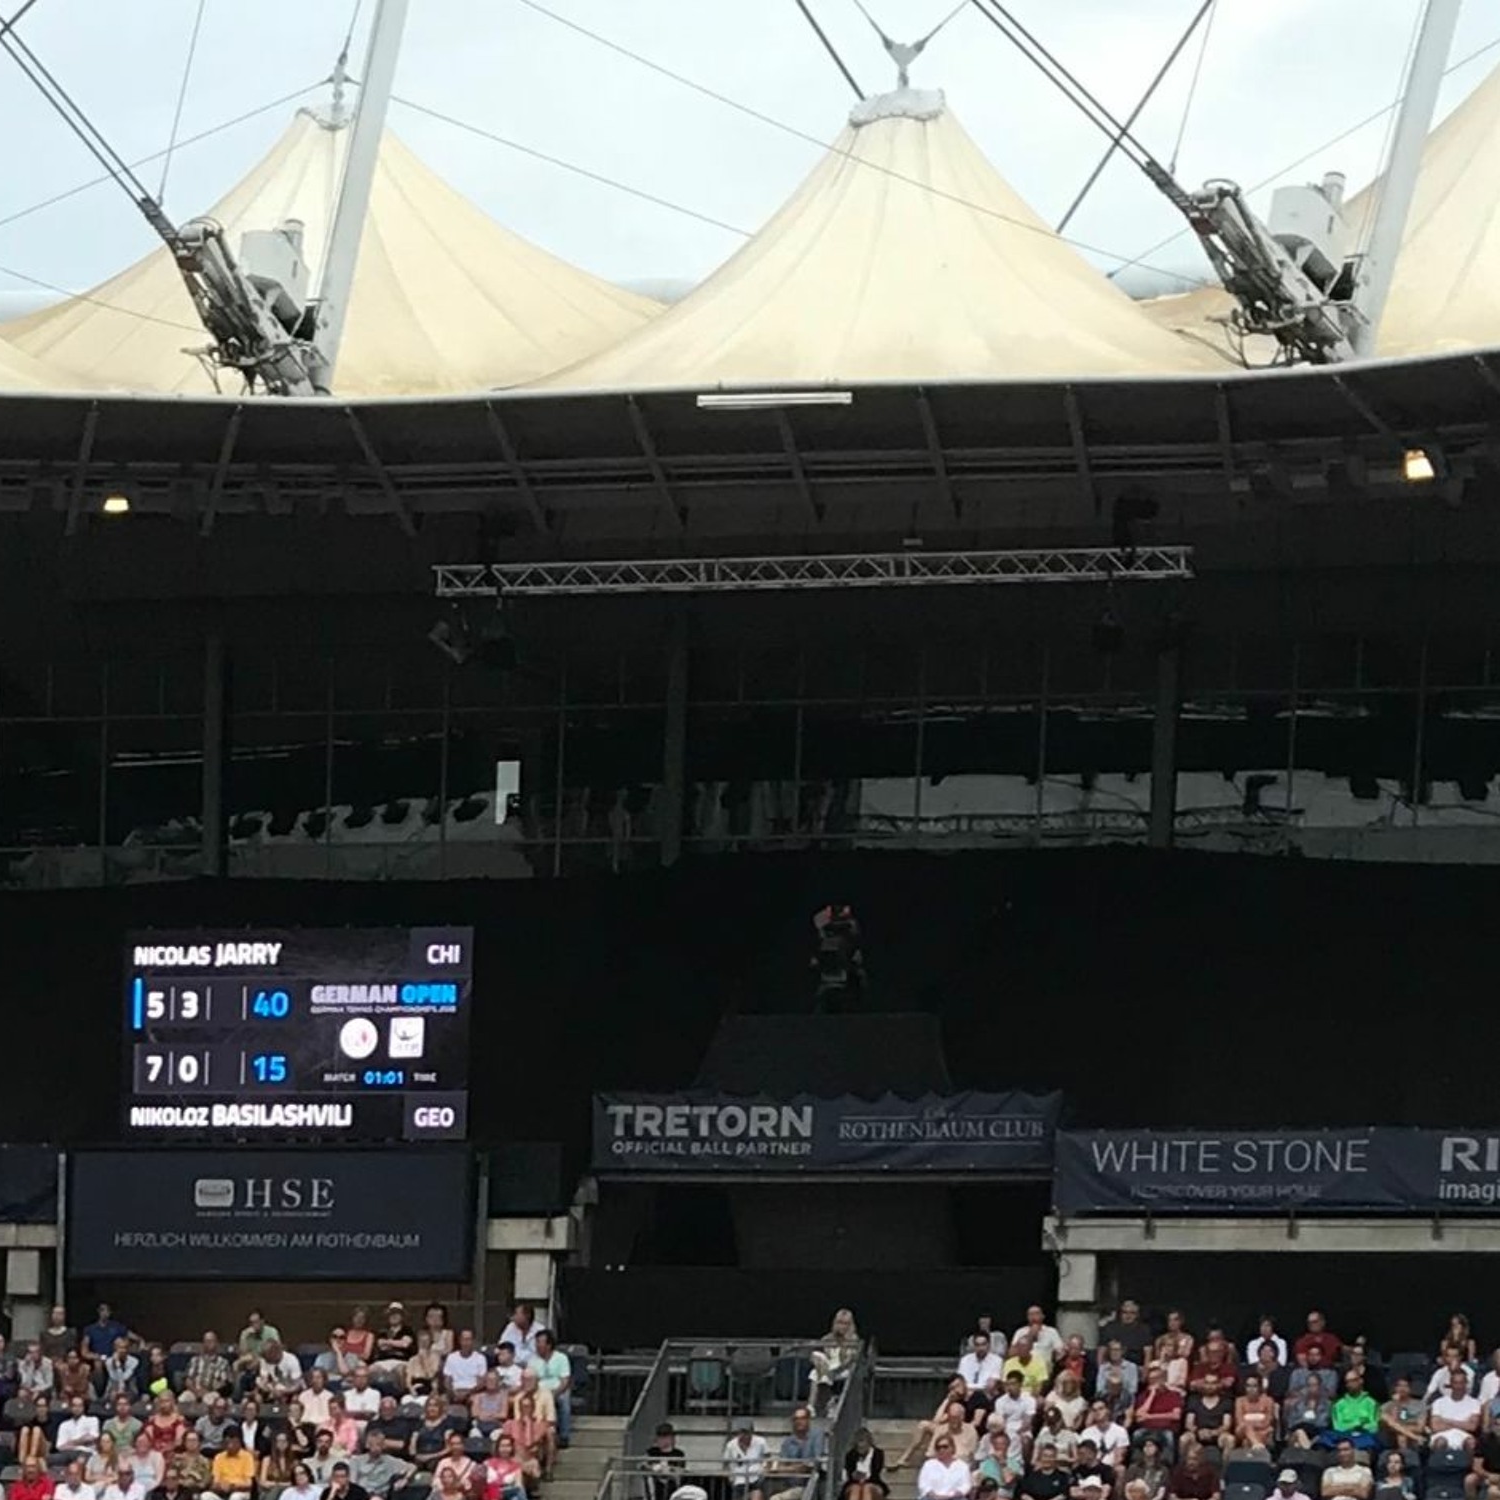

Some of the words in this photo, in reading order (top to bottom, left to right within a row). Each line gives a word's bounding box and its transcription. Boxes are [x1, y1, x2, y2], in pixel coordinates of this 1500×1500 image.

[133, 945, 211, 966] NICOLAS
[214, 942, 282, 967] JARRY
[426, 944, 461, 964] CHI
[146, 991, 165, 1019] 5
[180, 991, 199, 1019] 3
[253, 991, 289, 1018] 40
[310, 984, 397, 1005] GERMAN
[400, 983, 457, 1005] OPEN
[146, 1056, 164, 1083] 7
[178, 1055, 199, 1083] 0
[253, 1056, 287, 1082] 15
[363, 1071, 404, 1085] 01:01
[130, 1106, 209, 1127] NIKOLOZ
[211, 1104, 352, 1127] BASILASHVILI
[414, 1107, 454, 1128] GEO
[606, 1104, 813, 1139] TRETORN
[838, 1120, 985, 1140] ROTHENBAUM
[989, 1119, 1044, 1139] CLUB
[611, 1140, 686, 1156] OFFICIAL
[690, 1140, 732, 1156] BALL
[736, 1141, 812, 1156] PARTNER
[1092, 1139, 1220, 1174] WHITE
[1231, 1139, 1370, 1174] STONE
[244, 1178, 335, 1208] HSE
[114, 1232, 188, 1249] HERZLICH
[188, 1233, 290, 1249] WILLKOMMEN
[290, 1233, 314, 1249] AM
[316, 1233, 421, 1249] ROTHENBAUM
